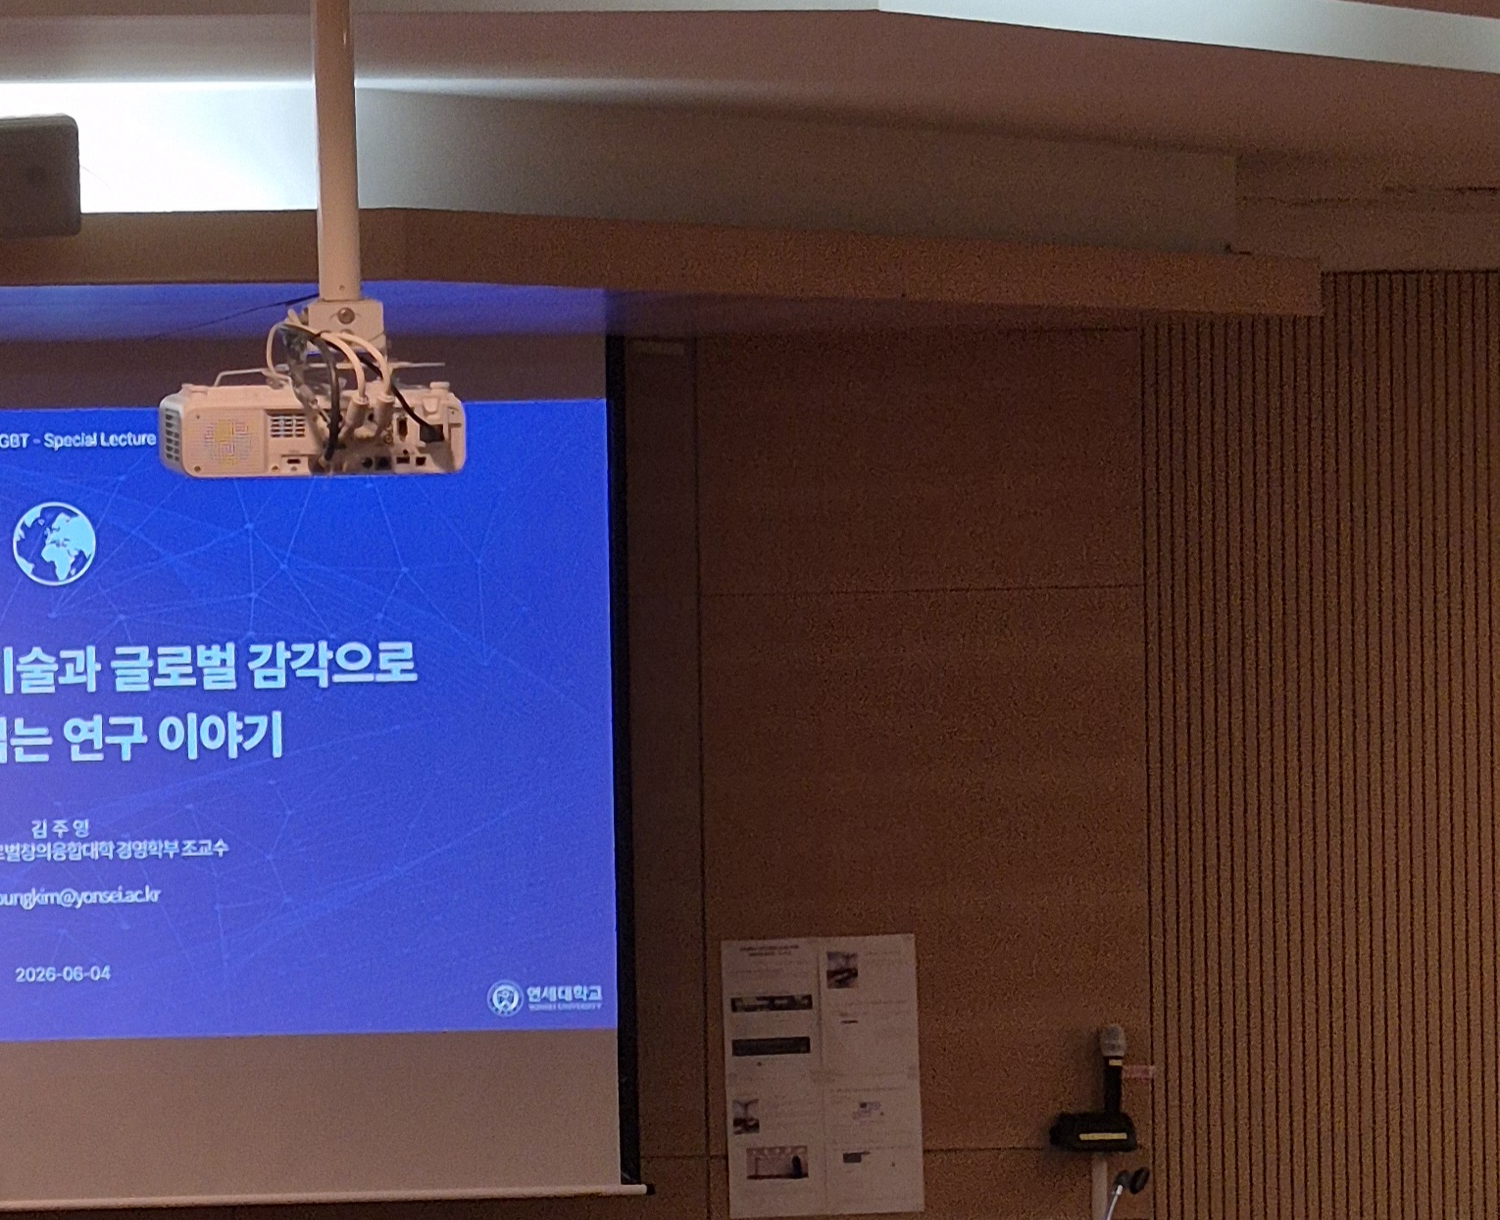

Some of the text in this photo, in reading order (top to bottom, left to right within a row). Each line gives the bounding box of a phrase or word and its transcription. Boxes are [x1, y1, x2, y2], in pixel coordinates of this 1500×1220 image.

[43, 432, 98, 451] Special
[100, 431, 157, 447] Lecture
[110, 642, 238, 692] 글로벌
[248, 640, 418, 689] 감각으로
[63, 714, 149, 762] 연구
[159, 710, 283, 760] 이야기
[31, 819, 90, 839] 김 주 영
[116, 838, 180, 860] 경영학부
[181, 838, 230, 859] 조교수
[15, 965, 111, 982] 2026-06-04
[527, 985, 603, 1002] 연세대학교
